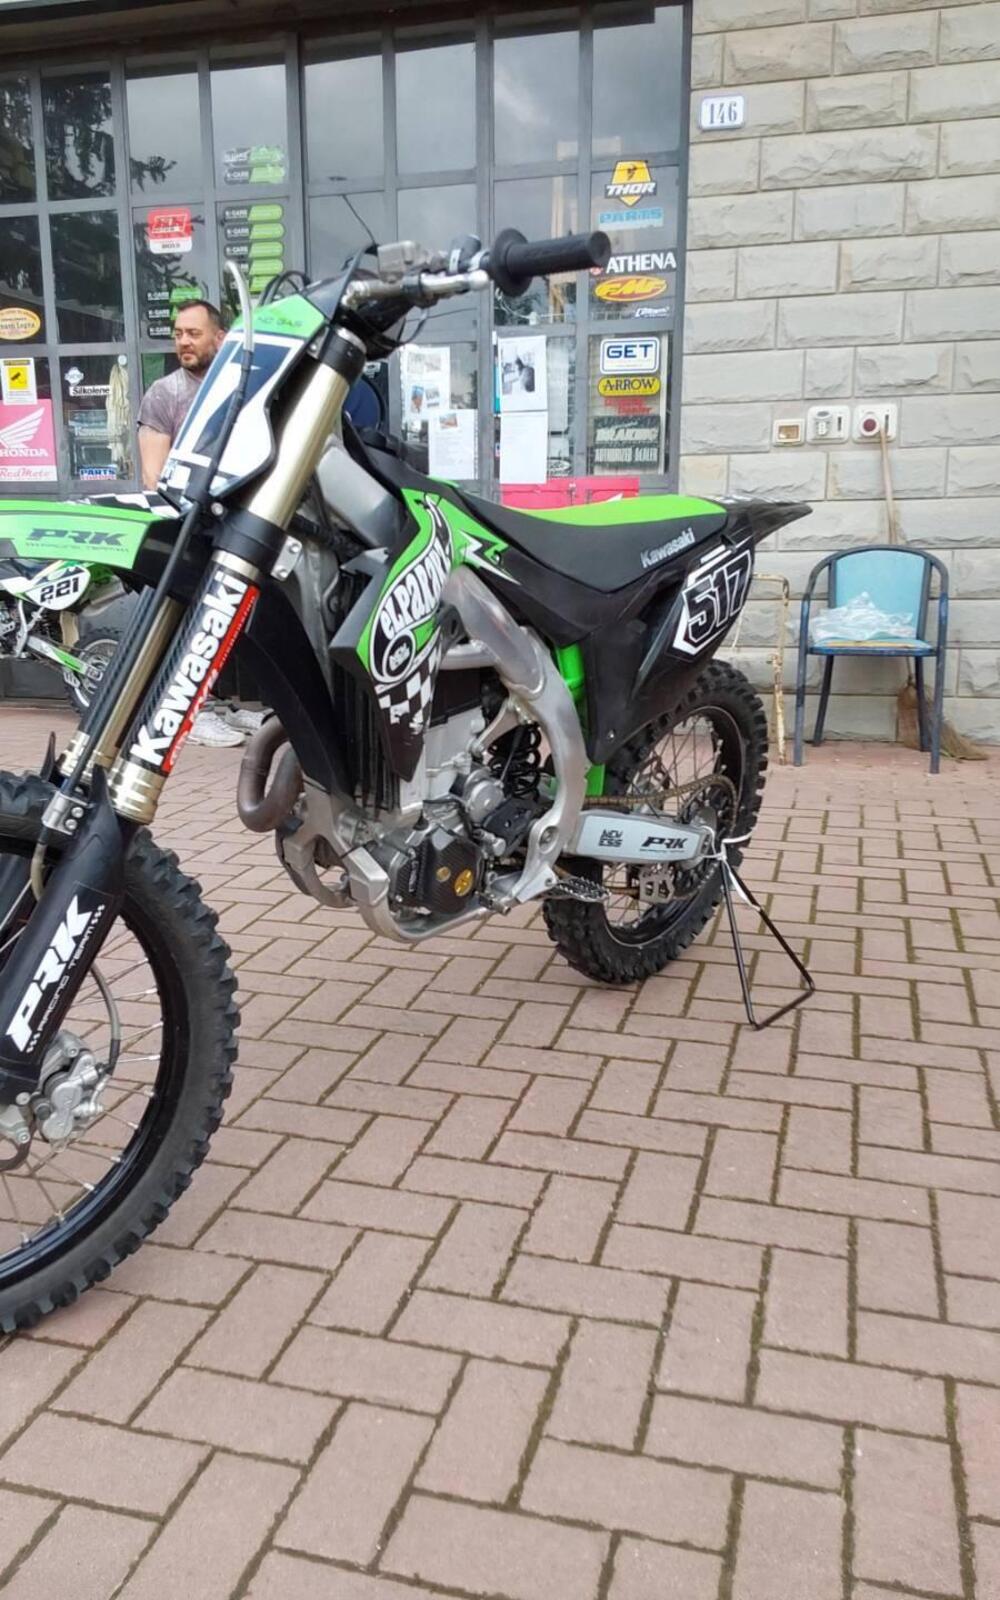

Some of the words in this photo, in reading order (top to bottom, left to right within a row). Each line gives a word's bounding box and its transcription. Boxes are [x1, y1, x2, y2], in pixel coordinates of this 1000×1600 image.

[709, 101, 738, 125] 146
[606, 181, 657, 197] THOR
[605, 251, 677, 274] ATHENA
[597, 278, 667, 296] FMF
[606, 343, 654, 359] GET
[72, 385, 110, 395] Silkolene
[603, 378, 656, 392] ARROW
[0, 447, 49, 457] HONDA
[80, 468, 116, 476] PARTS
[26, 528, 129, 546] PRK
[641, 527, 696, 568] Kawasaki
[40, 577, 80, 603] 221
[681, 549, 752, 643] 517
[130, 571, 249, 767] Kawasaki
[641, 836, 689, 849] PRK
[5, 894, 93, 1053] PRK
[38, 974, 70, 1032] RACING
[67, 925, 95, 970] TEAM
